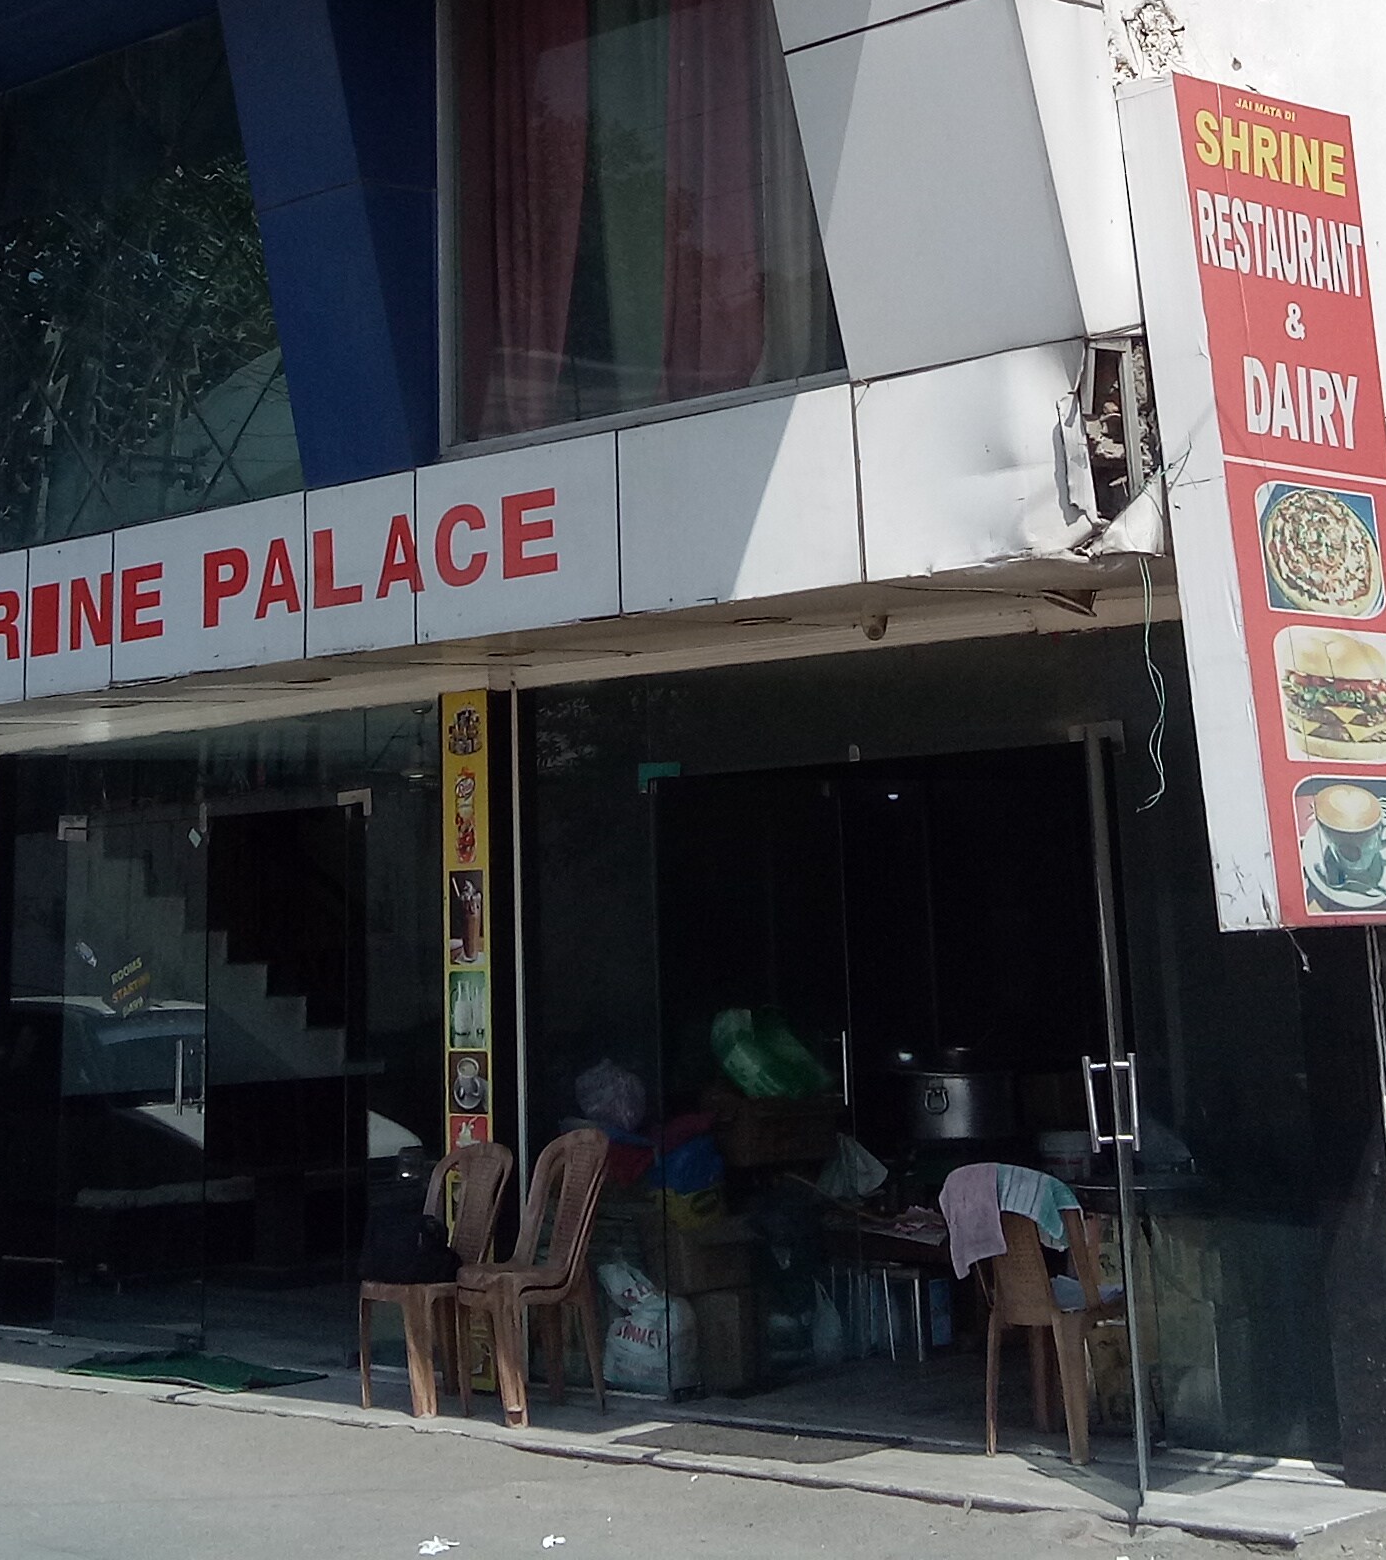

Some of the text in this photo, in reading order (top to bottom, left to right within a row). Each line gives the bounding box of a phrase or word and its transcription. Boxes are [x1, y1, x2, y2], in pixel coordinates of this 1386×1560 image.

[1195, 109, 1346, 197] SHRINE
[1235, 97, 1297, 123] JAI MATA DI
[1196, 188, 1363, 298] RESTAURANT
[1285, 302, 1305, 340] &
[1243, 355, 1358, 450] DAIRY
[203, 487, 559, 628] PALACE
